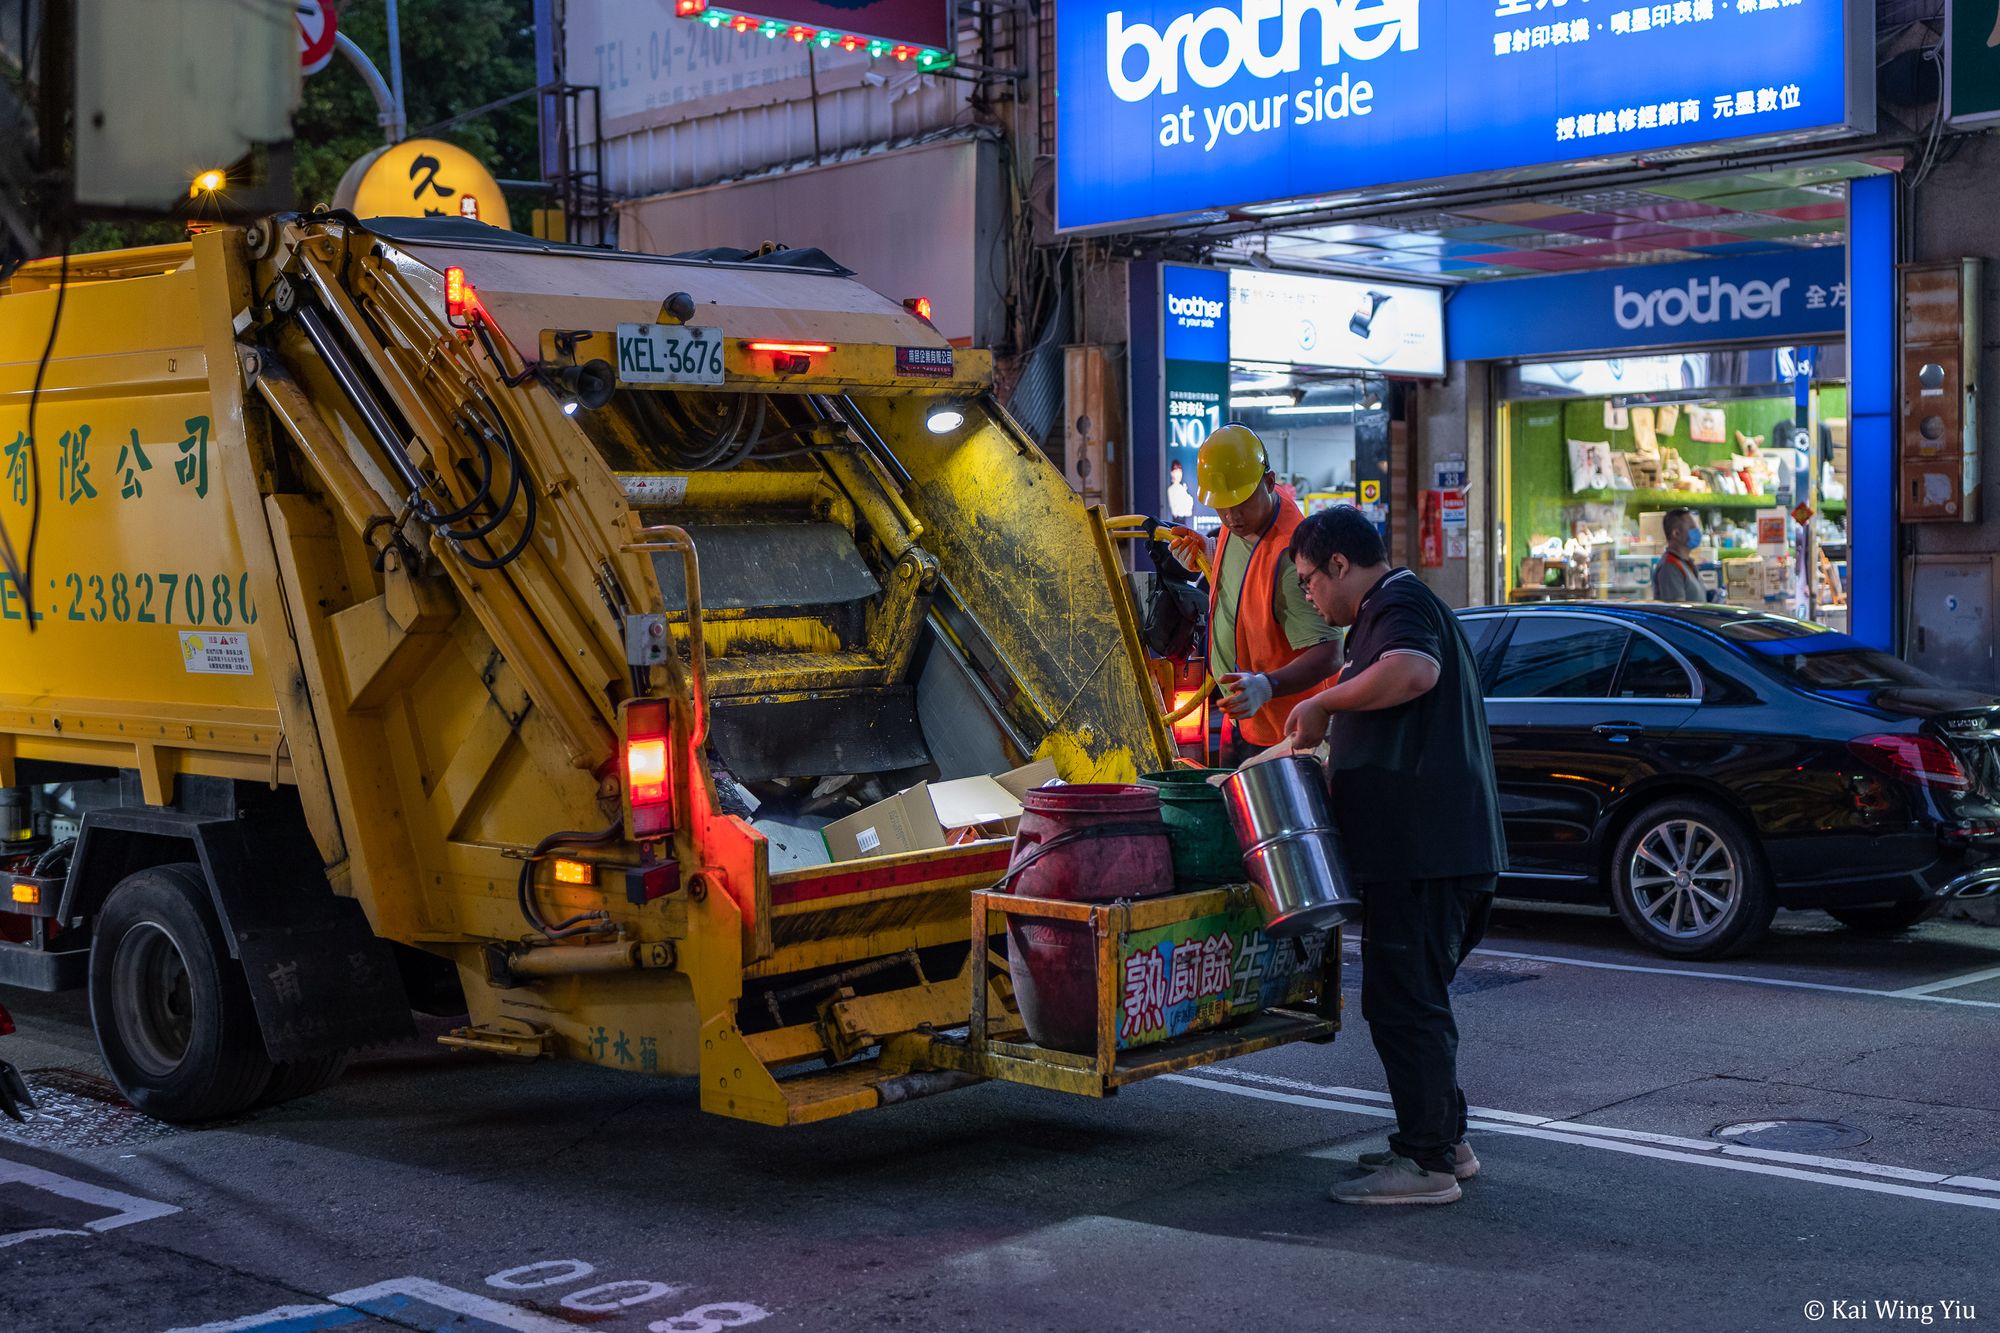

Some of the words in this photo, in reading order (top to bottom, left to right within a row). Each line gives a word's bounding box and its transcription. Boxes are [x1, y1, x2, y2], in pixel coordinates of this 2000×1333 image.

[1106, 0, 1420, 101] brother
[1159, 104, 1195, 147] at
[1204, 93, 1289, 152] your
[1294, 72, 1374, 125] side
[1556, 99, 1701, 141] 授權維修經銷商
[1713, 83, 1801, 119] 元墨數位
[1168, 293, 1224, 318] brother
[1178, 317, 1186, 326] at
[1186, 318, 1201, 328] your
[1614, 276, 1791, 330] brother
[4, 415, 211, 507] 有限公司
[1444, 473, 1460, 487] 33
